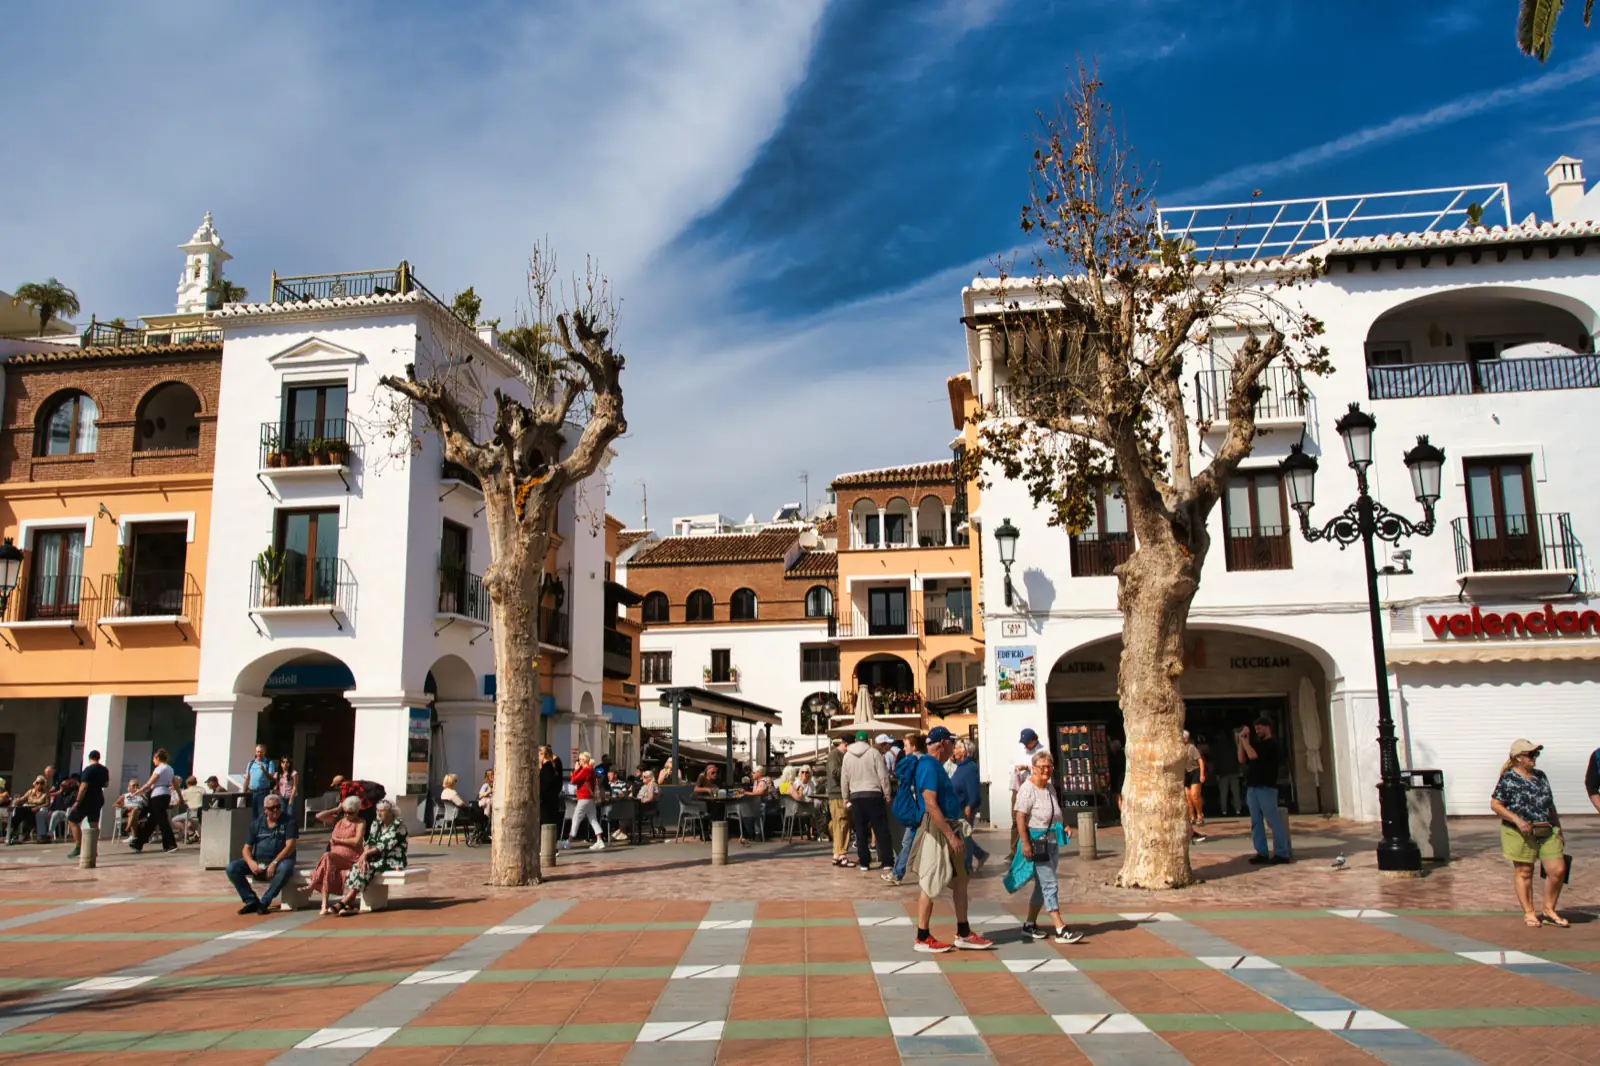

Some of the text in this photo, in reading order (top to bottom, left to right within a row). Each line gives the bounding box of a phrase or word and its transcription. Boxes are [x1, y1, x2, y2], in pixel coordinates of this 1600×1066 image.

[997, 650, 1024, 659] EDIFICIO
[1230, 656, 1290, 669] ICECREAM
[1011, 691, 1035, 700] EUROPA
